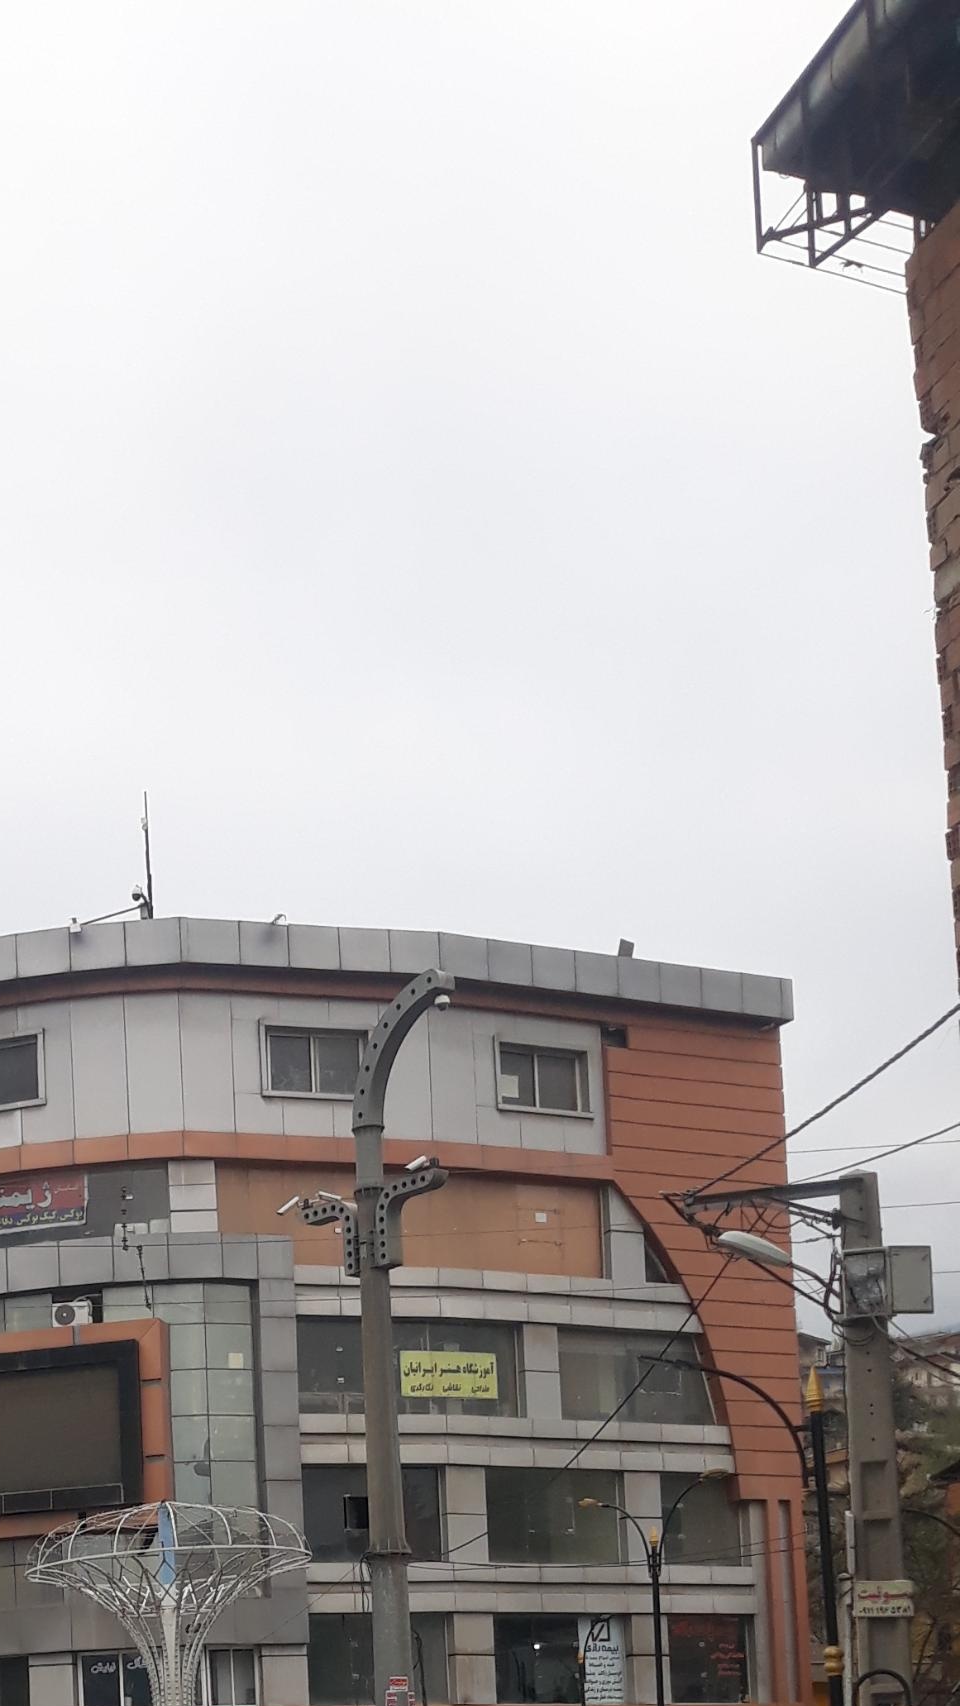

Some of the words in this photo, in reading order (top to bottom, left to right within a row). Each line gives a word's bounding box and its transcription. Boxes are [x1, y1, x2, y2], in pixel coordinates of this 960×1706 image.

[403, 1361, 437, 1377] ایرانیان
[439, 1363, 461, 1377] هنر
[462, 1362, 494, 1379] آموزشگاه
[601, 1644, 619, 1654] بیمه
